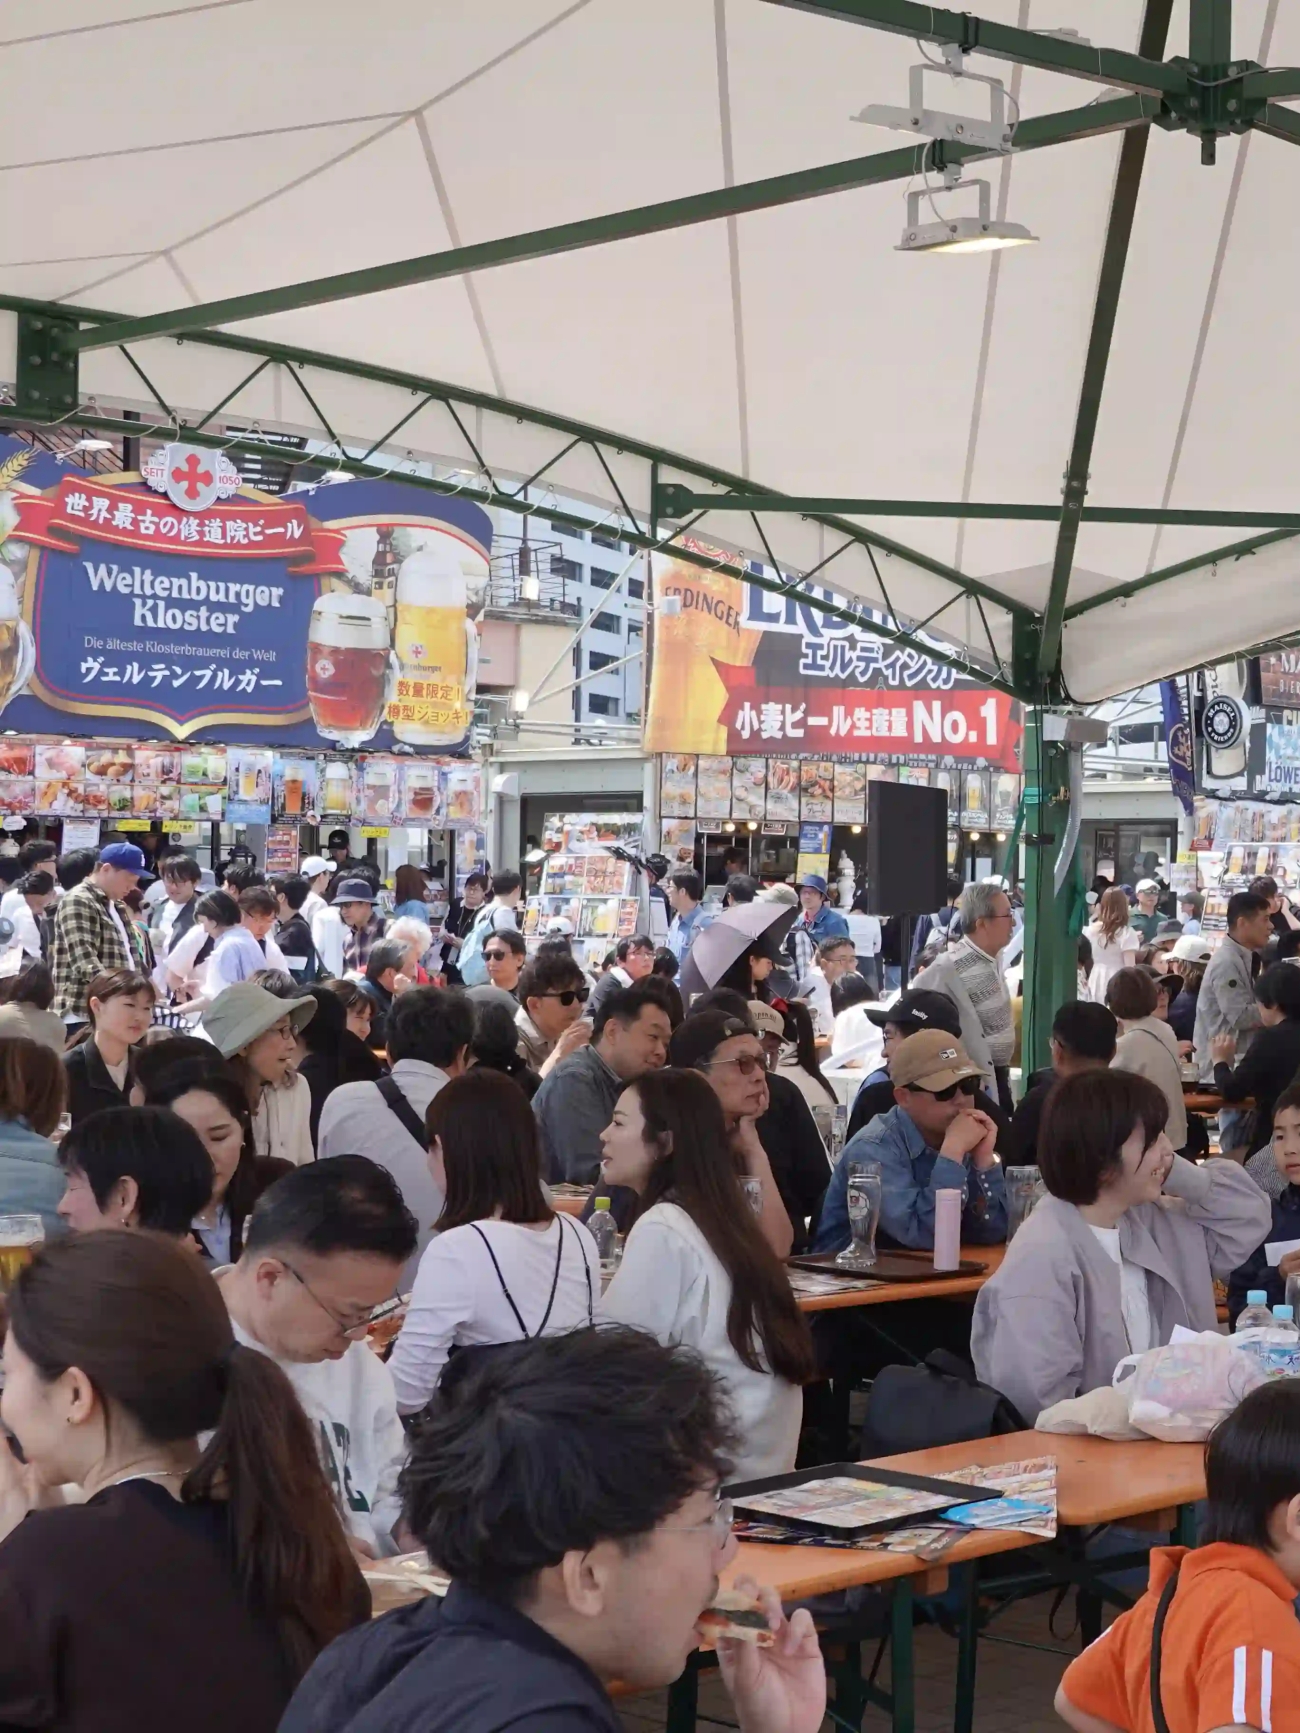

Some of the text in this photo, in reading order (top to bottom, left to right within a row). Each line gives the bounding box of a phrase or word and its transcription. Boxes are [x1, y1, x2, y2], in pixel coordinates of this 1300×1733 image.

[143, 467, 165, 479] SEIT
[218, 475, 241, 487] 1050
[65, 493, 304, 545] 世界最古の修道院ビール
[82, 561, 285, 613] Weltenburger
[132, 598, 240, 634] Kloster
[84, 635, 277, 662] Die älteste Klosterbrauerei der Welt
[80, 656, 283, 693] ヴェルテンブルガー
[735, 698, 998, 745] 小麦ビール生産量 No.1
[1208, 702, 1235, 720] MAISEL
[1210, 728, 1235, 743] FRIENDS
